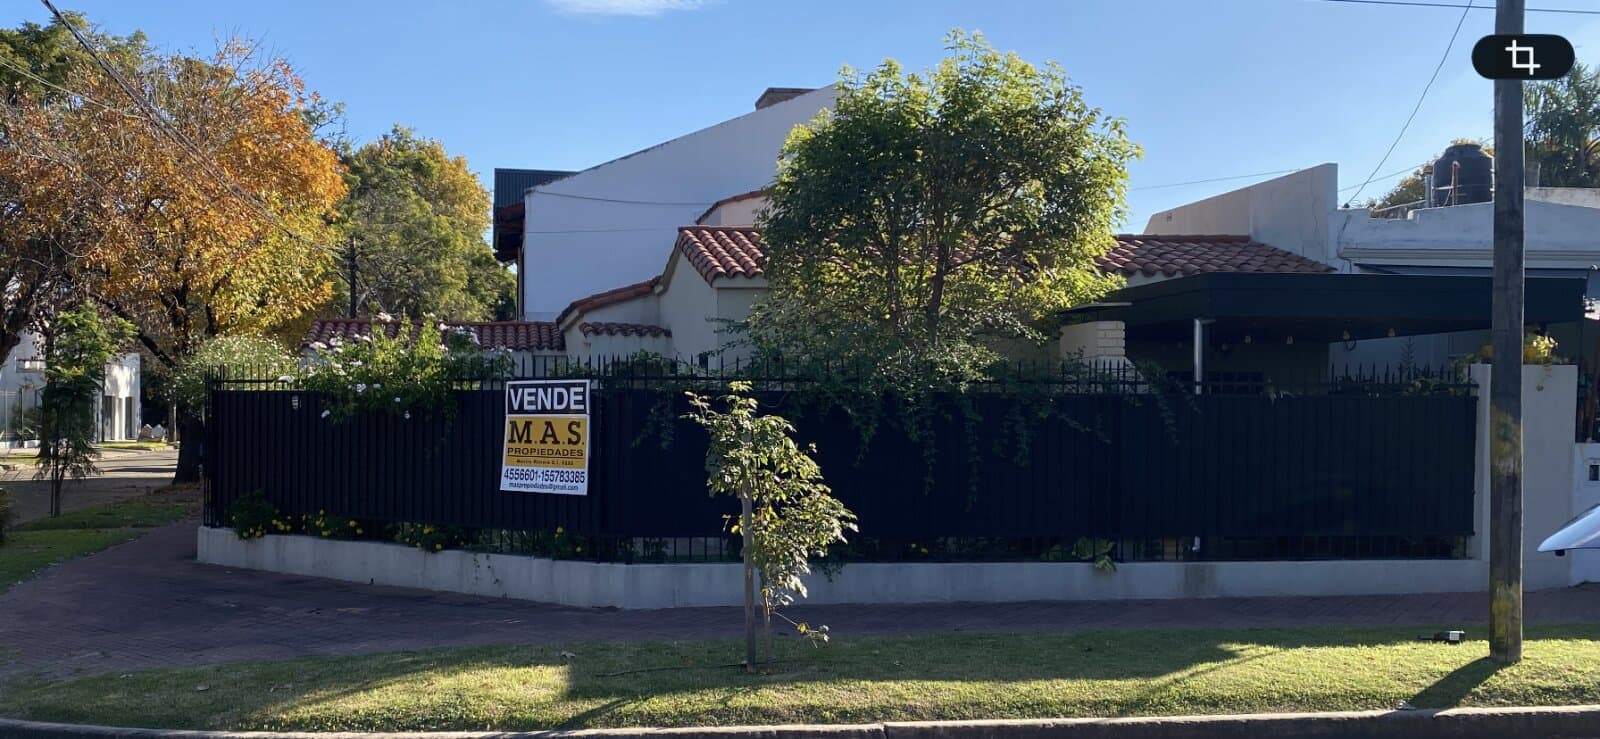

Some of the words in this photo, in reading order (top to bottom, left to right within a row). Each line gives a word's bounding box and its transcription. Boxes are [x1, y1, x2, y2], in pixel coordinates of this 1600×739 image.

[509, 387, 585, 411] VENDE
[508, 420, 585, 446] M.A.S.
[507, 447, 584, 457] PROPIEDADES
